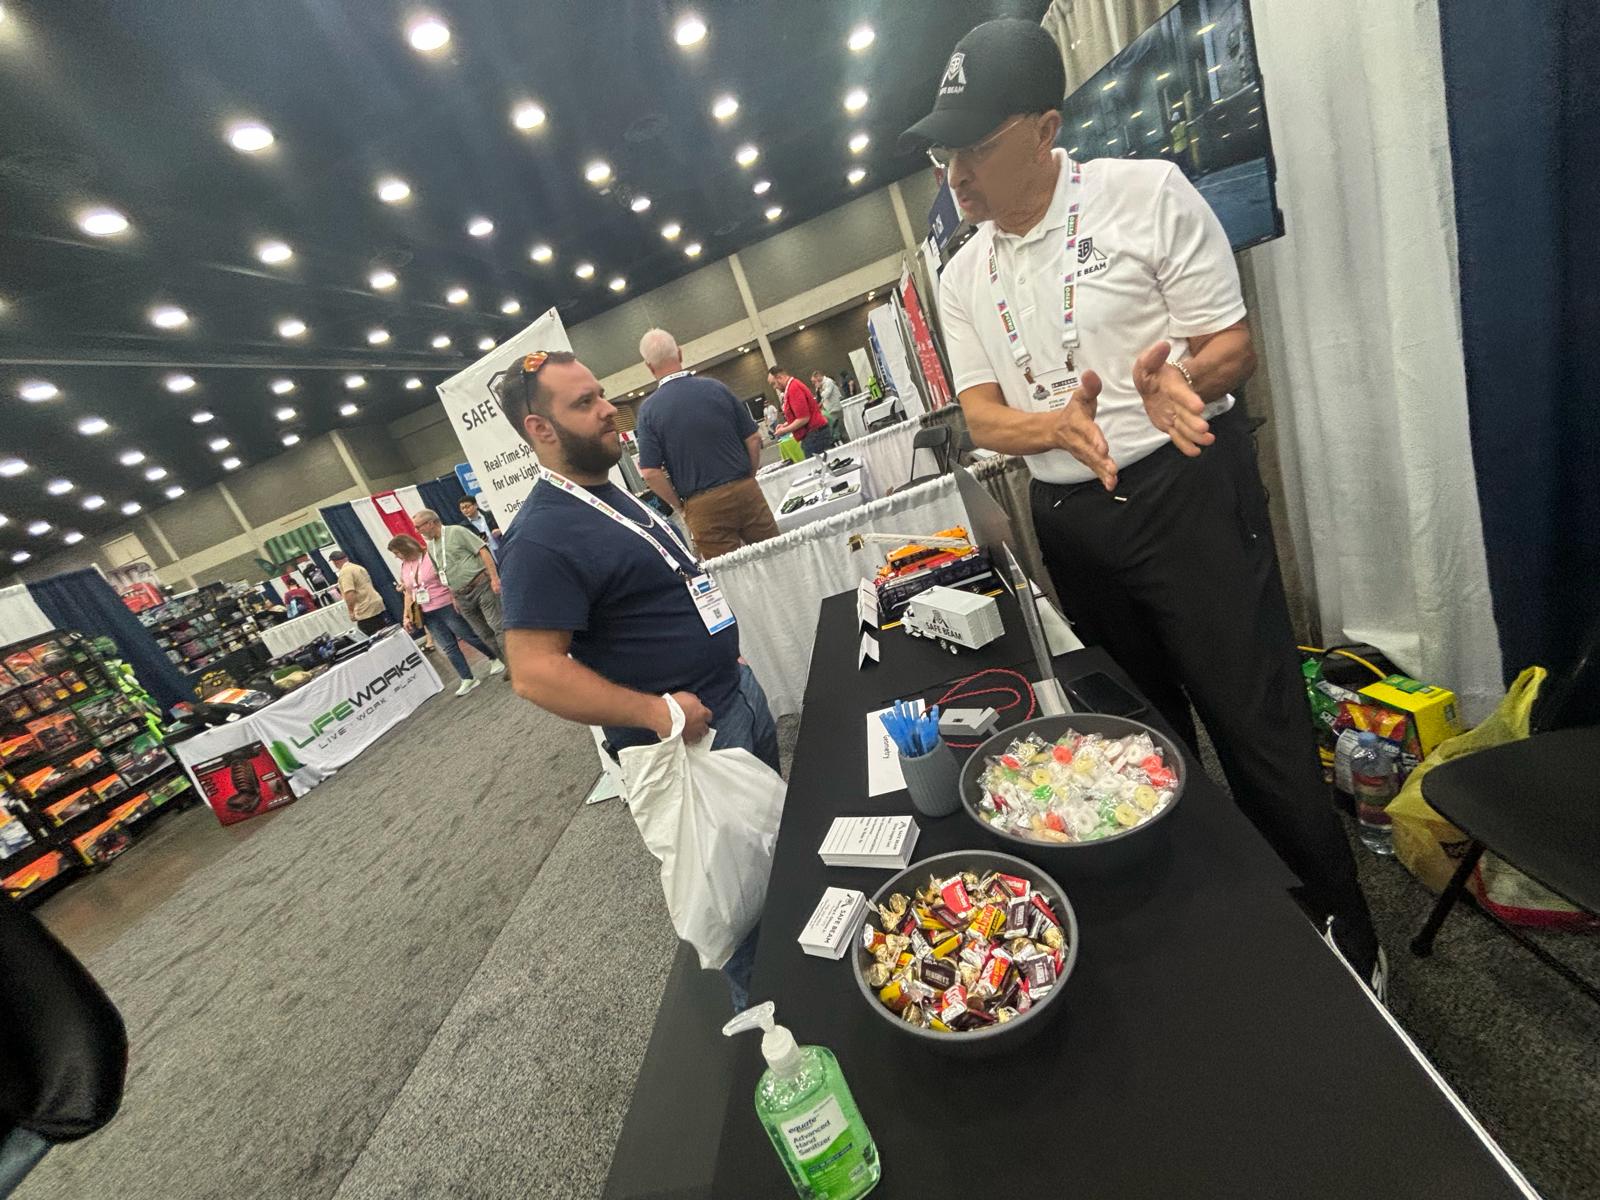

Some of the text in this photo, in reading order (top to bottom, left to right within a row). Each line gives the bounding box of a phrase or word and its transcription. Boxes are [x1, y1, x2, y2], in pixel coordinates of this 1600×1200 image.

[1084, 262, 1107, 276] BEAM
[461, 399, 498, 431] SAFE
[483, 448, 521, 473] Real-Time
[492, 478, 505, 491] for
[506, 462, 541, 486] Low-Light
[925, 621, 963, 641] SAFE BEAM
[289, 651, 423, 749] LIFEWORKS
[318, 726, 347, 750] LIVE
[356, 697, 387, 721] WORK
[824, 910, 847, 944] SAFE BEAM
[788, 1116, 818, 1134] equate
[793, 1120, 831, 1143] Advanced
[795, 1137, 817, 1150] Hand
[798, 1135, 832, 1156] Sanitizer
